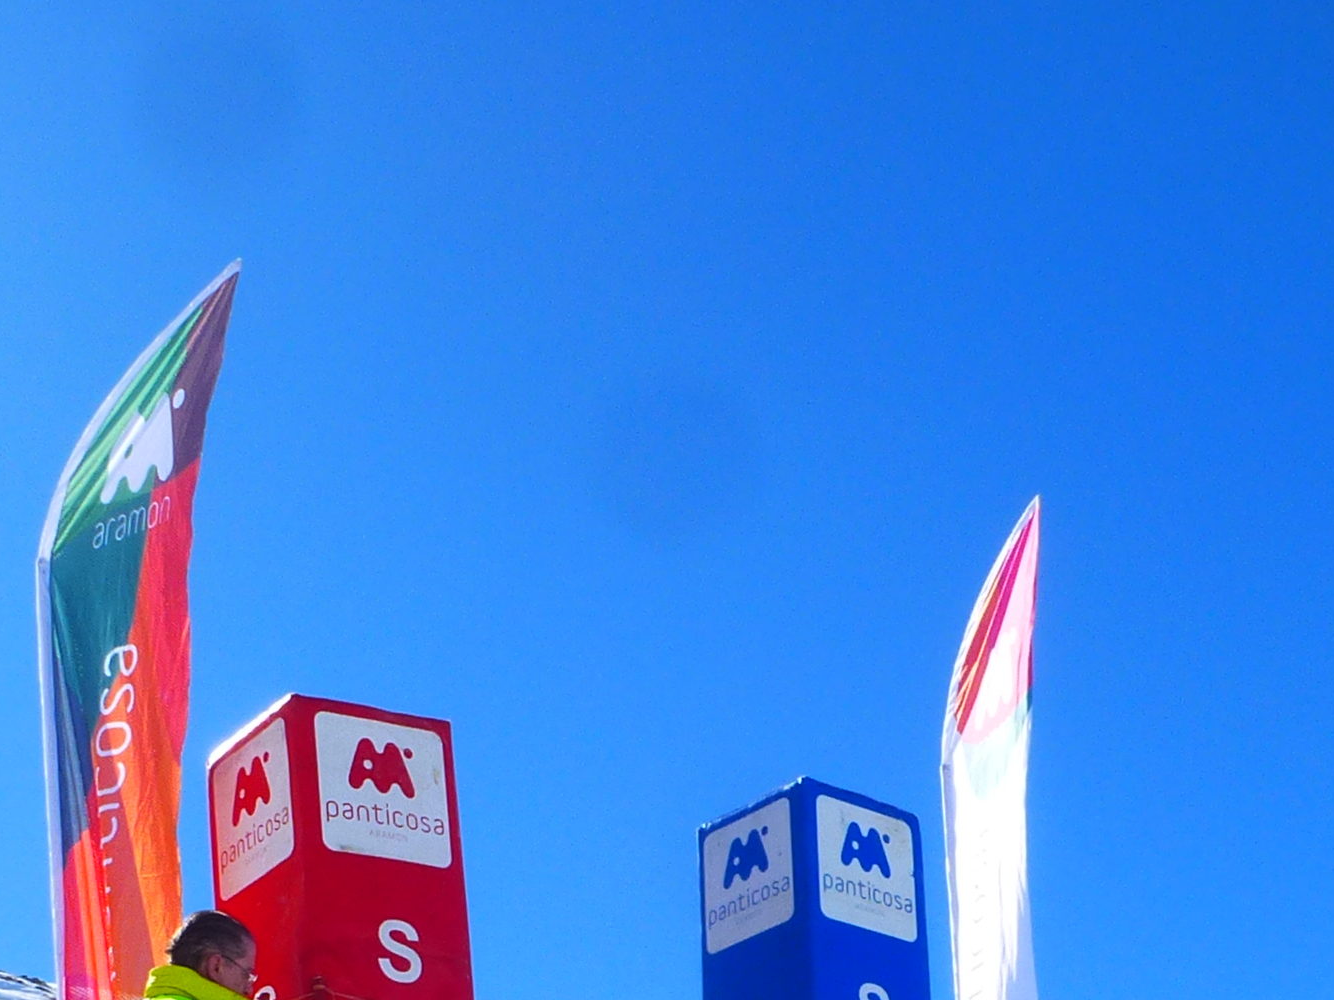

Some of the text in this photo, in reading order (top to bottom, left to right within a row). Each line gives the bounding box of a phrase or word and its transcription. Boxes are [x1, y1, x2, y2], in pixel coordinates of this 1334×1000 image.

[92, 495, 171, 549] aramon
[221, 806, 290, 874] panticosa
[326, 800, 445, 836] panticosa
[708, 876, 790, 930] panticosa
[823, 873, 913, 914] panticosa
